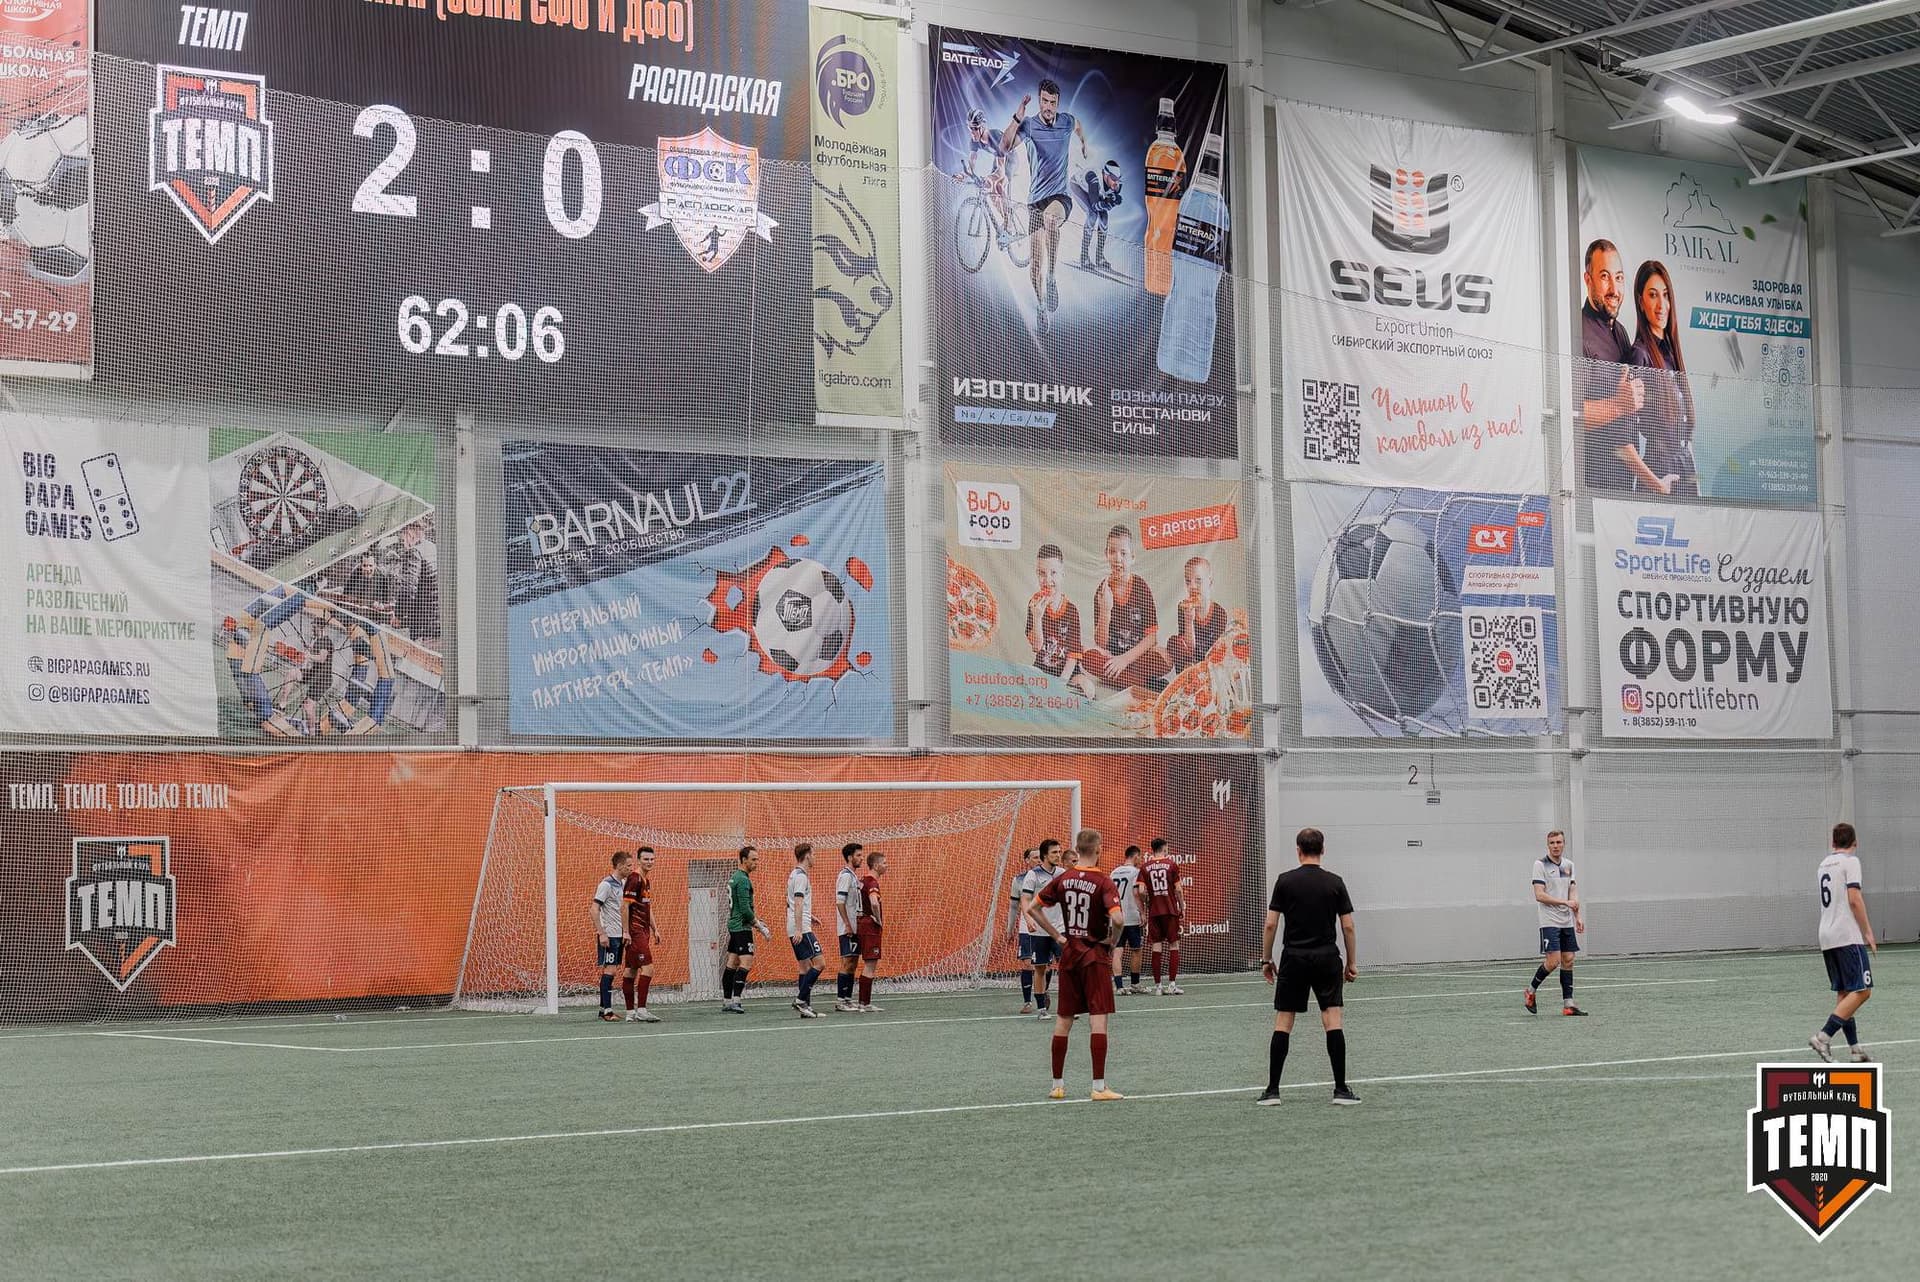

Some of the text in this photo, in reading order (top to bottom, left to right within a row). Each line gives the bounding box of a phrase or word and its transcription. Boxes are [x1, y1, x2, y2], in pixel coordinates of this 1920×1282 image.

[180, 5, 249, 52] ТЕМП
[0, 46, 75, 63] БОЛЬНАЯ
[628, 63, 782, 117] РАСПАДСКАЯ
[162, 118, 261, 183] ТЕМП
[814, 134, 887, 158] Молодёжная
[352, 104, 417, 217] 2
[543, 129, 603, 239] 0
[816, 151, 887, 173] футбольная
[1665, 232, 1740, 264] BAIKAL
[1330, 259, 1493, 314] SEUS
[1752, 279, 1802, 296] ЗДОРОВАЯ
[1705, 291, 1803, 312] И КРАСИВАЯ УЛЫБКА
[0, 308, 77, 332] -57-29
[398, 296, 565, 363] 62:06
[1375, 316, 1453, 339] Export Union
[1698, 311, 1803, 335] ЖДЕТ ТЕБЯ ЗДЕСЬ!
[1331, 334, 1493, 360] СИБИРСКИЙ ЭКСПОРТНЫЙ СОЮЗ
[953, 377, 1093, 406] ИЗОТОНИК
[1111, 389, 1174, 404] ВОЗЬМИ
[1371, 385, 1455, 421] Чемпион
[1112, 405, 1211, 422] ВОССТАНОВИ
[1113, 421, 1160, 436] СИЛЫ.
[1376, 404, 1523, 455] каждом из нас!
[23, 451, 56, 479] BIG
[25, 481, 75, 511] PAPA
[1097, 492, 1148, 512] Друзья
[25, 509, 92, 541] GAMES
[1161, 513, 1222, 537] детства
[1635, 516, 1690, 548] SL
[26, 562, 82, 586] АРЕНДА
[1615, 549, 1711, 575] SportLife
[1716, 552, 1814, 594] Создаем
[26, 588, 129, 614] РАЗВЛЕЧЕНИЙ
[1617, 589, 1810, 625] СПОРТИВНУЮ
[26, 614, 196, 641] НА ВАШЕ МЕРОПРИЯТИЕ
[530, 592, 642, 639] ГЕНЕРАЛЬНЫЙ
[531, 619, 682, 677] ИНФОРМАЦИОННЫЙ
[1619, 626, 1810, 684] ФОРМУ
[47, 657, 151, 678] BIGPAPAGAMES.RU
[48, 684, 151, 705] @BIGPAPAGAMES
[532, 675, 602, 711] ПАРТНЕР
[605, 668, 634, 692] ФК
[1645, 687, 1760, 715] sportlifebrn
[1408, 764, 1418, 785] 2
[9, 784, 229, 813] ТЕМП, ТЕМП, ТОЛЬКО ТЕМП!
[1150, 869, 1168, 892] 63
[1820, 873, 1832, 908] 6
[78, 881, 165, 932] ТЕМП
[1065, 890, 1091, 930] 33
[605, 952, 615, 964] 18
[1863, 970, 1872, 985] 6
